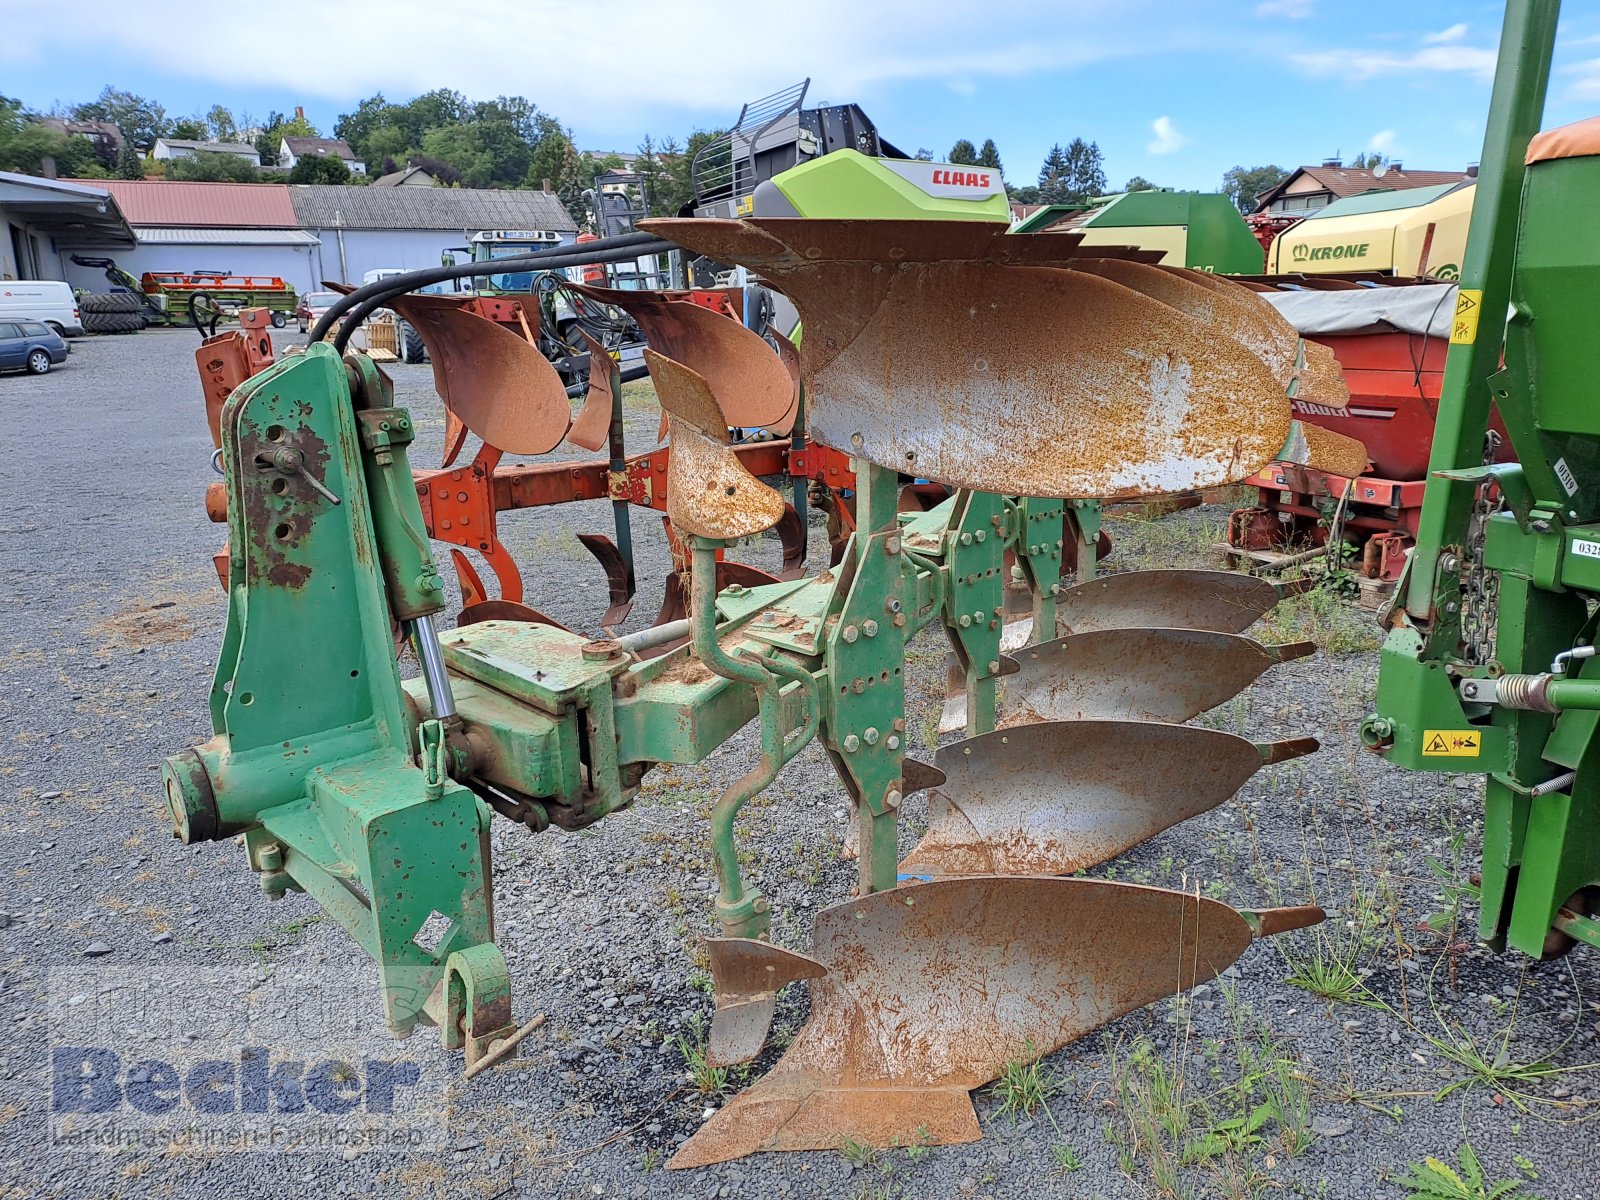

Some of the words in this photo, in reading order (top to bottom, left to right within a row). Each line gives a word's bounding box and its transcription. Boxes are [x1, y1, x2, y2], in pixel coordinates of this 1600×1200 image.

[933, 169, 990, 188] CLAAS
[1309, 243, 1370, 261] KRONE
[1557, 464, 1575, 490] 01319
